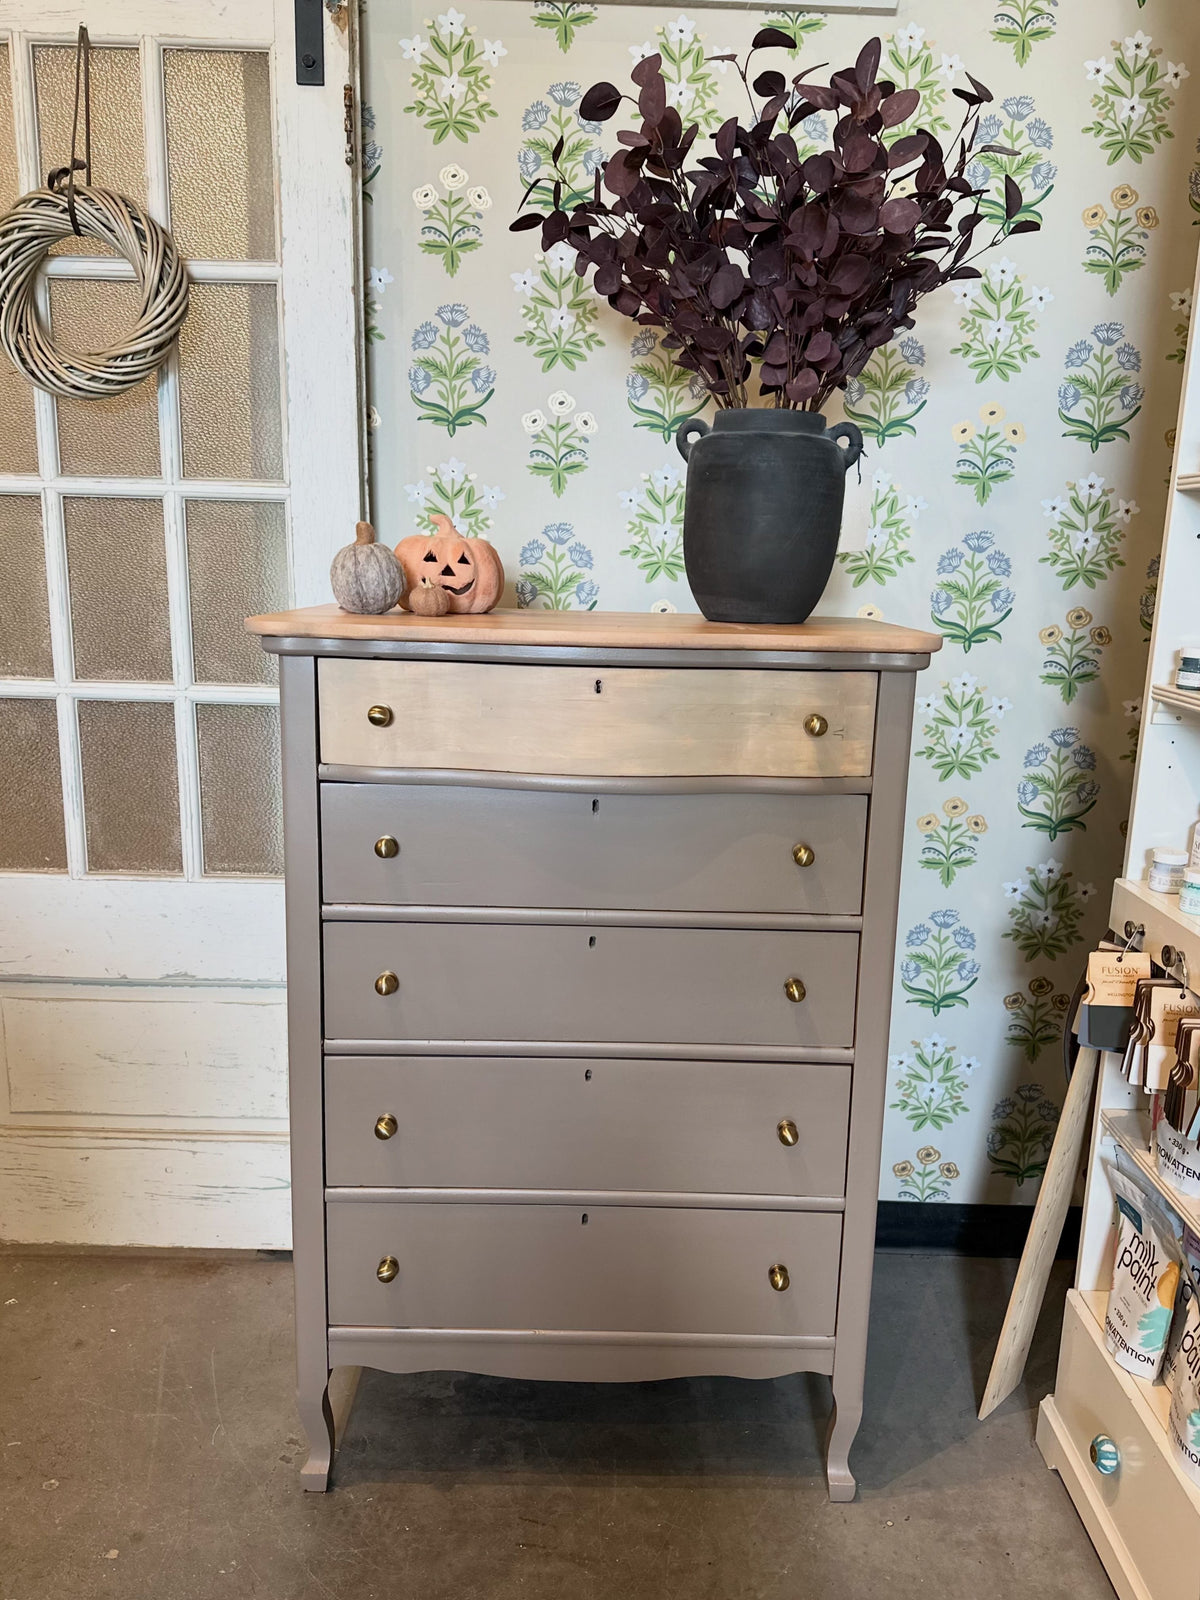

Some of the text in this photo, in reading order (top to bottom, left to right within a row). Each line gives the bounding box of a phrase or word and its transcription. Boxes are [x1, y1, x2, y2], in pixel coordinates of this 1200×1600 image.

[1101, 966, 1138, 975] FUSION
[1163, 1003, 1200, 1015] FUSION
[1171, 1138, 1183, 1150] 330
[1129, 1232, 1160, 1278] milk
[1117, 1246, 1158, 1302] paint
